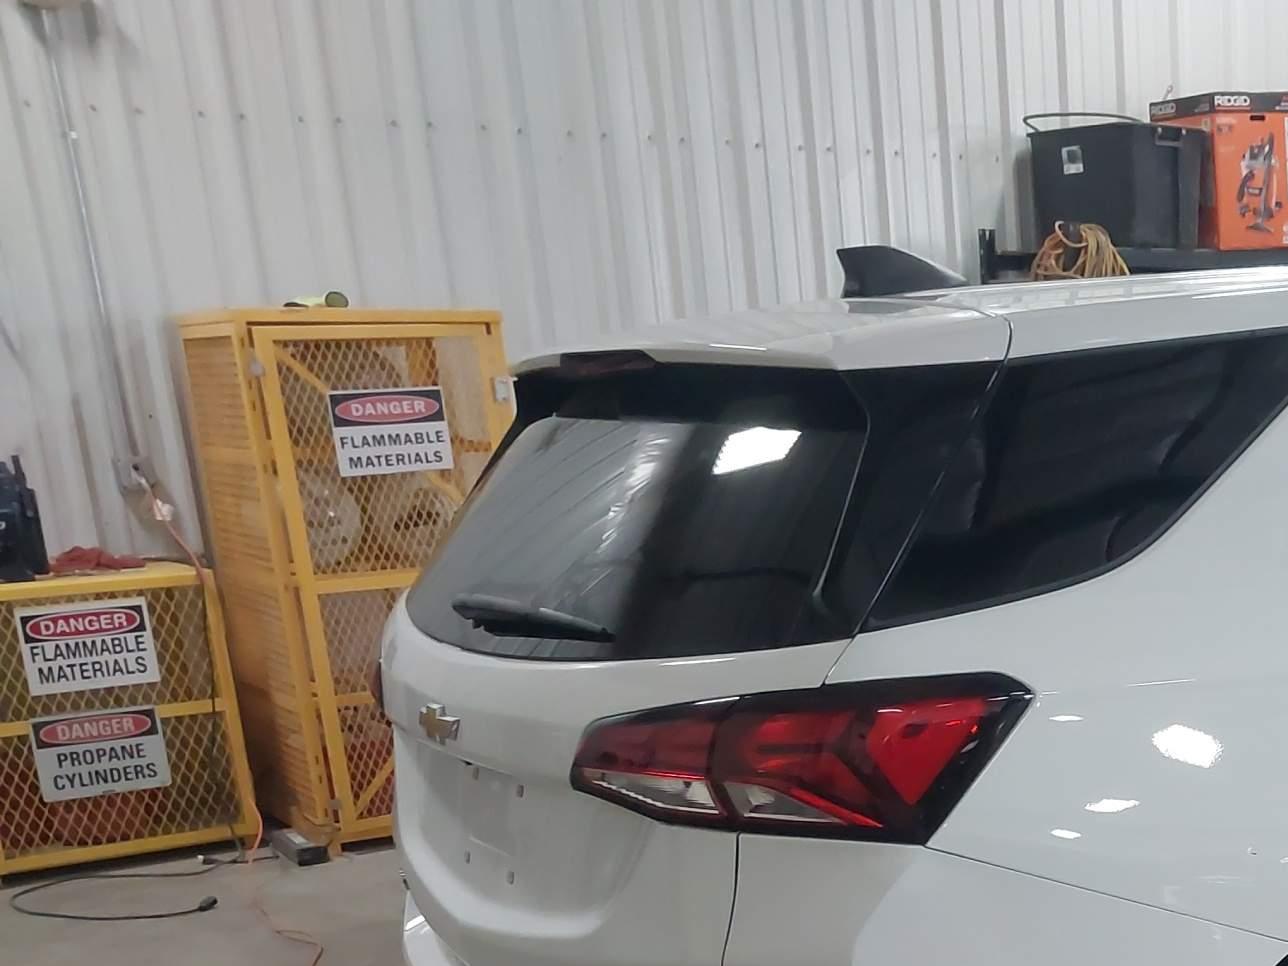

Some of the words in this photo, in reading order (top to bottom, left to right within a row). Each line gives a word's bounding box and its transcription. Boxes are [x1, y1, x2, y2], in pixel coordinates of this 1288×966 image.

[1214, 95, 1251, 107] RIDGID
[350, 400, 426, 417] DANGER
[339, 430, 446, 450] FLAMMABLE
[348, 450, 443, 470] MATERIALS
[39, 612, 128, 636] DANGER
[29, 634, 148, 663] FLAMMABLE
[37, 656, 148, 685] MATERIALS
[55, 717, 135, 742] DANGER
[56, 743, 147, 769] PROPANE
[53, 762, 159, 791] CYLINDERS
